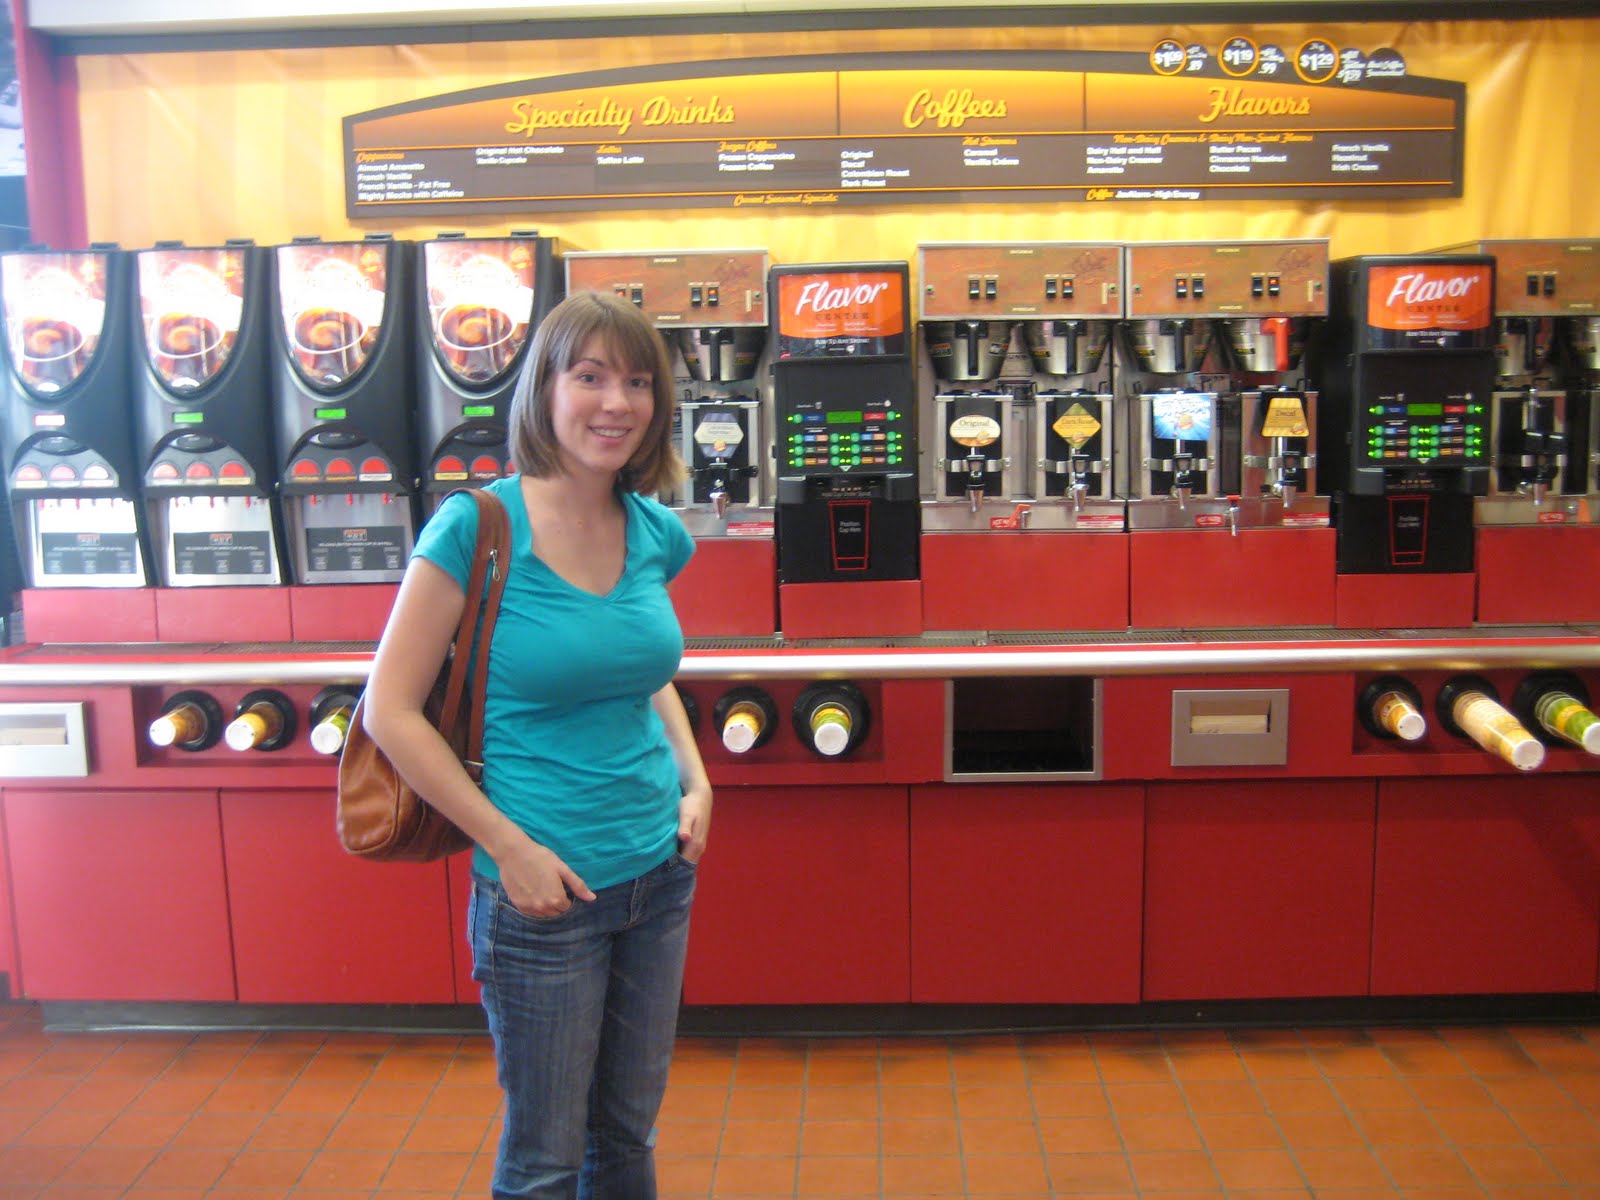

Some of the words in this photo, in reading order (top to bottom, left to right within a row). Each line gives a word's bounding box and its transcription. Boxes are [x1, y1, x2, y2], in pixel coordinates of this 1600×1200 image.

[903, 88, 1008, 128] Coffees
[1198, 86, 1311, 122] Flavors
[505, 97, 635, 137] Specialty
[641, 95, 735, 126] Drinks
[840, 150, 873, 160] Original
[357, 173, 386, 182] French
[386, 172, 413, 181] Vanilla
[358, 182, 386, 191] French
[386, 181, 413, 190] Vanilla
[418, 181, 432, 190] Fat
[432, 180, 452, 189] Free
[1386, 270, 1481, 307] Flavor
[795, 280, 889, 316] Flavor
[815, 312, 871, 321] CENTER
[1275, 409, 1297, 418] Decaf
[958, 419, 990, 429] Original
